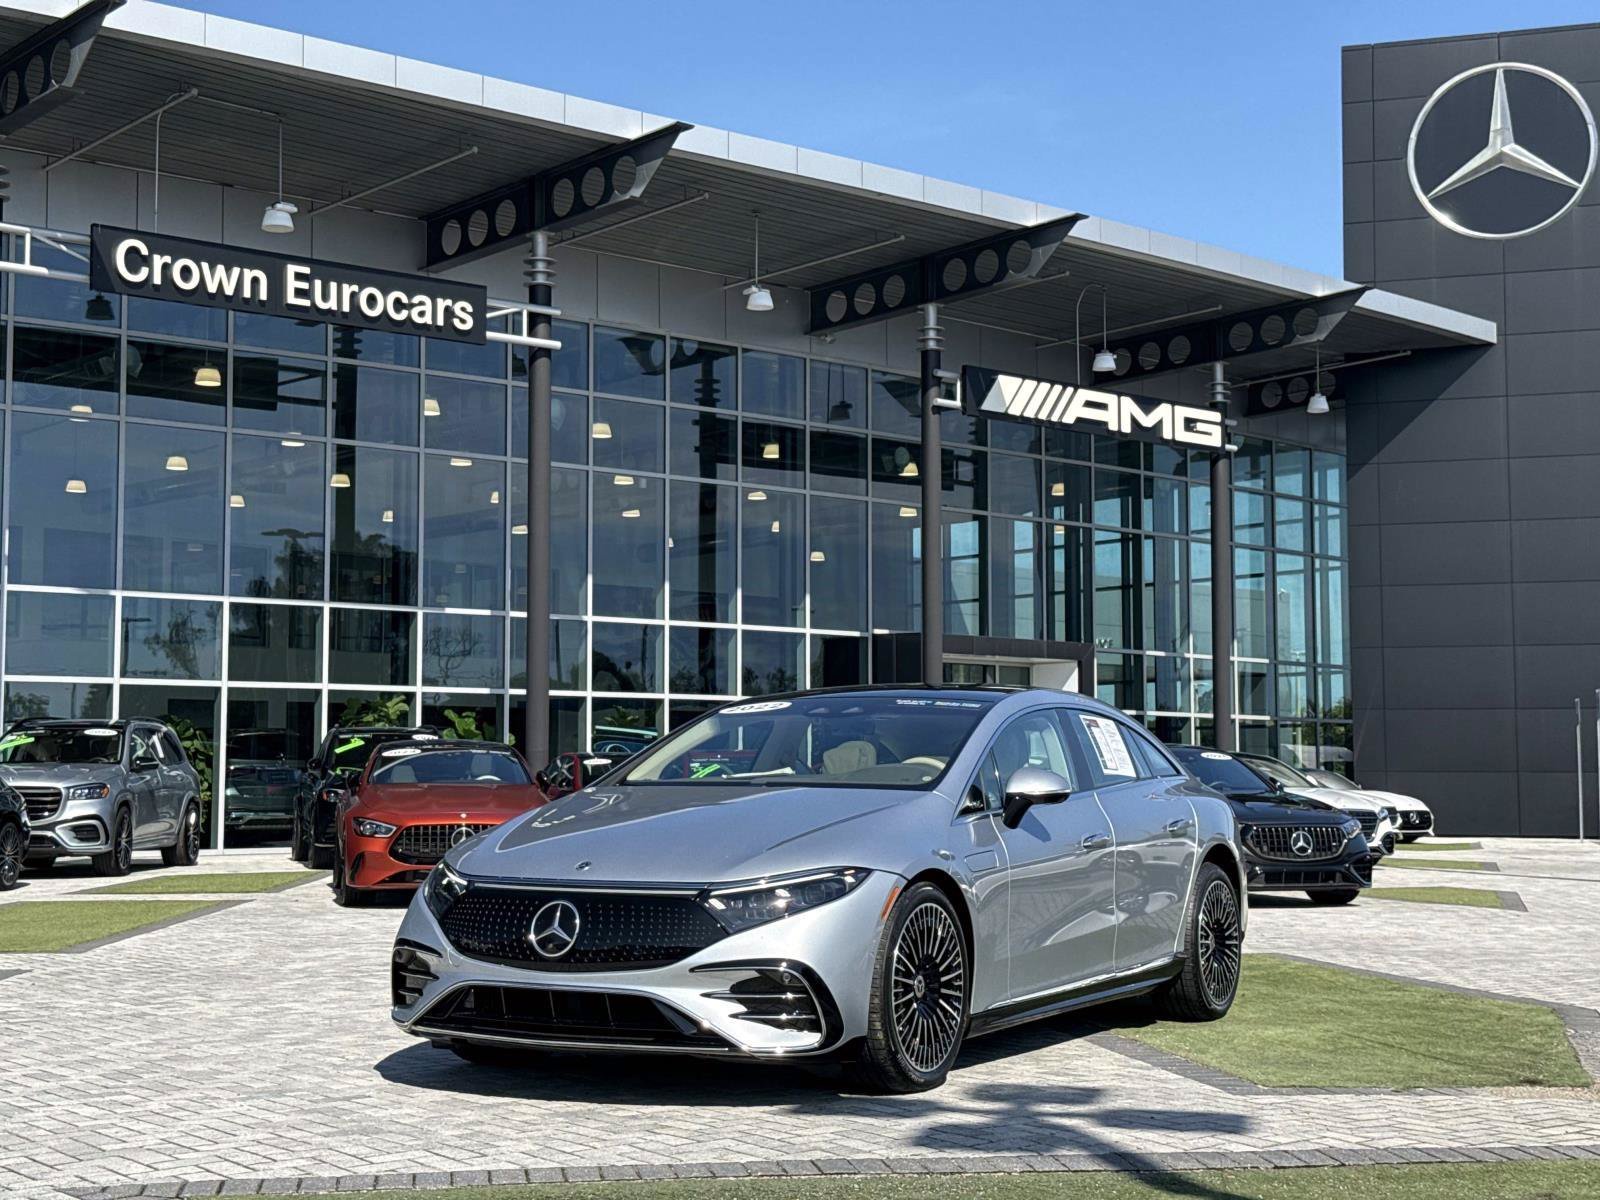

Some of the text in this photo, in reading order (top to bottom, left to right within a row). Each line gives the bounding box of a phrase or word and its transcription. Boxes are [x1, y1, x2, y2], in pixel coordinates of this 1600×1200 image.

[114, 237, 475, 332] Crown Eurocars
[1061, 387, 1223, 448] AMG
